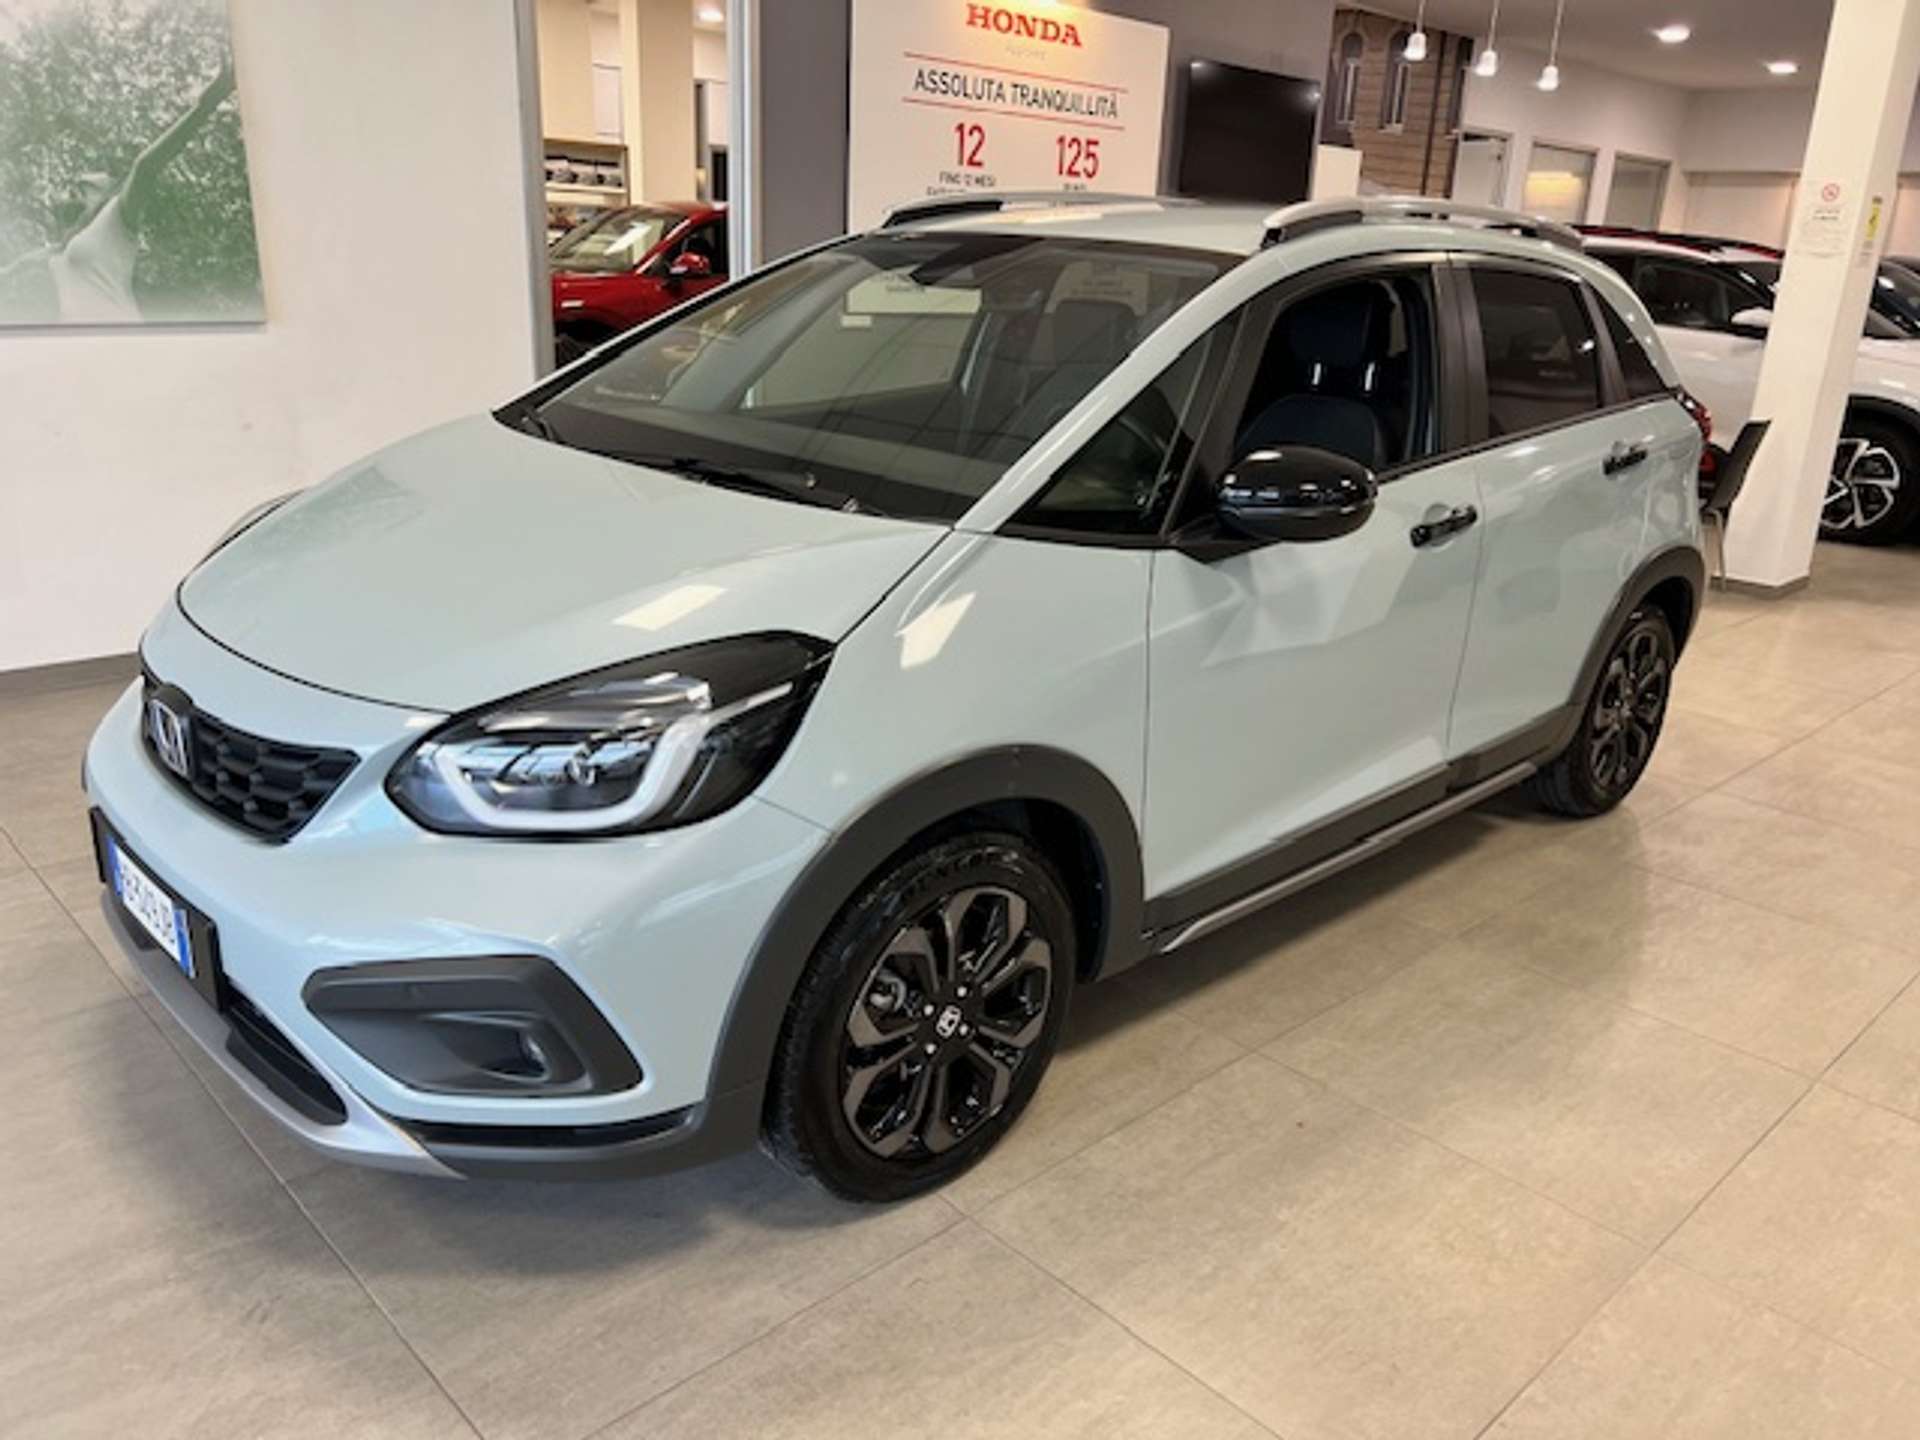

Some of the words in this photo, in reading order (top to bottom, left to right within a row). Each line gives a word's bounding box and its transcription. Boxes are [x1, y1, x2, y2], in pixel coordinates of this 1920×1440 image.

[966, 3, 1082, 48] HONDA
[914, 68, 1006, 104] ASSOLUTA
[1010, 83, 1118, 119] TRANQUILLITÀ
[954, 122, 986, 168] 12
[1056, 135, 1099, 179] 125
